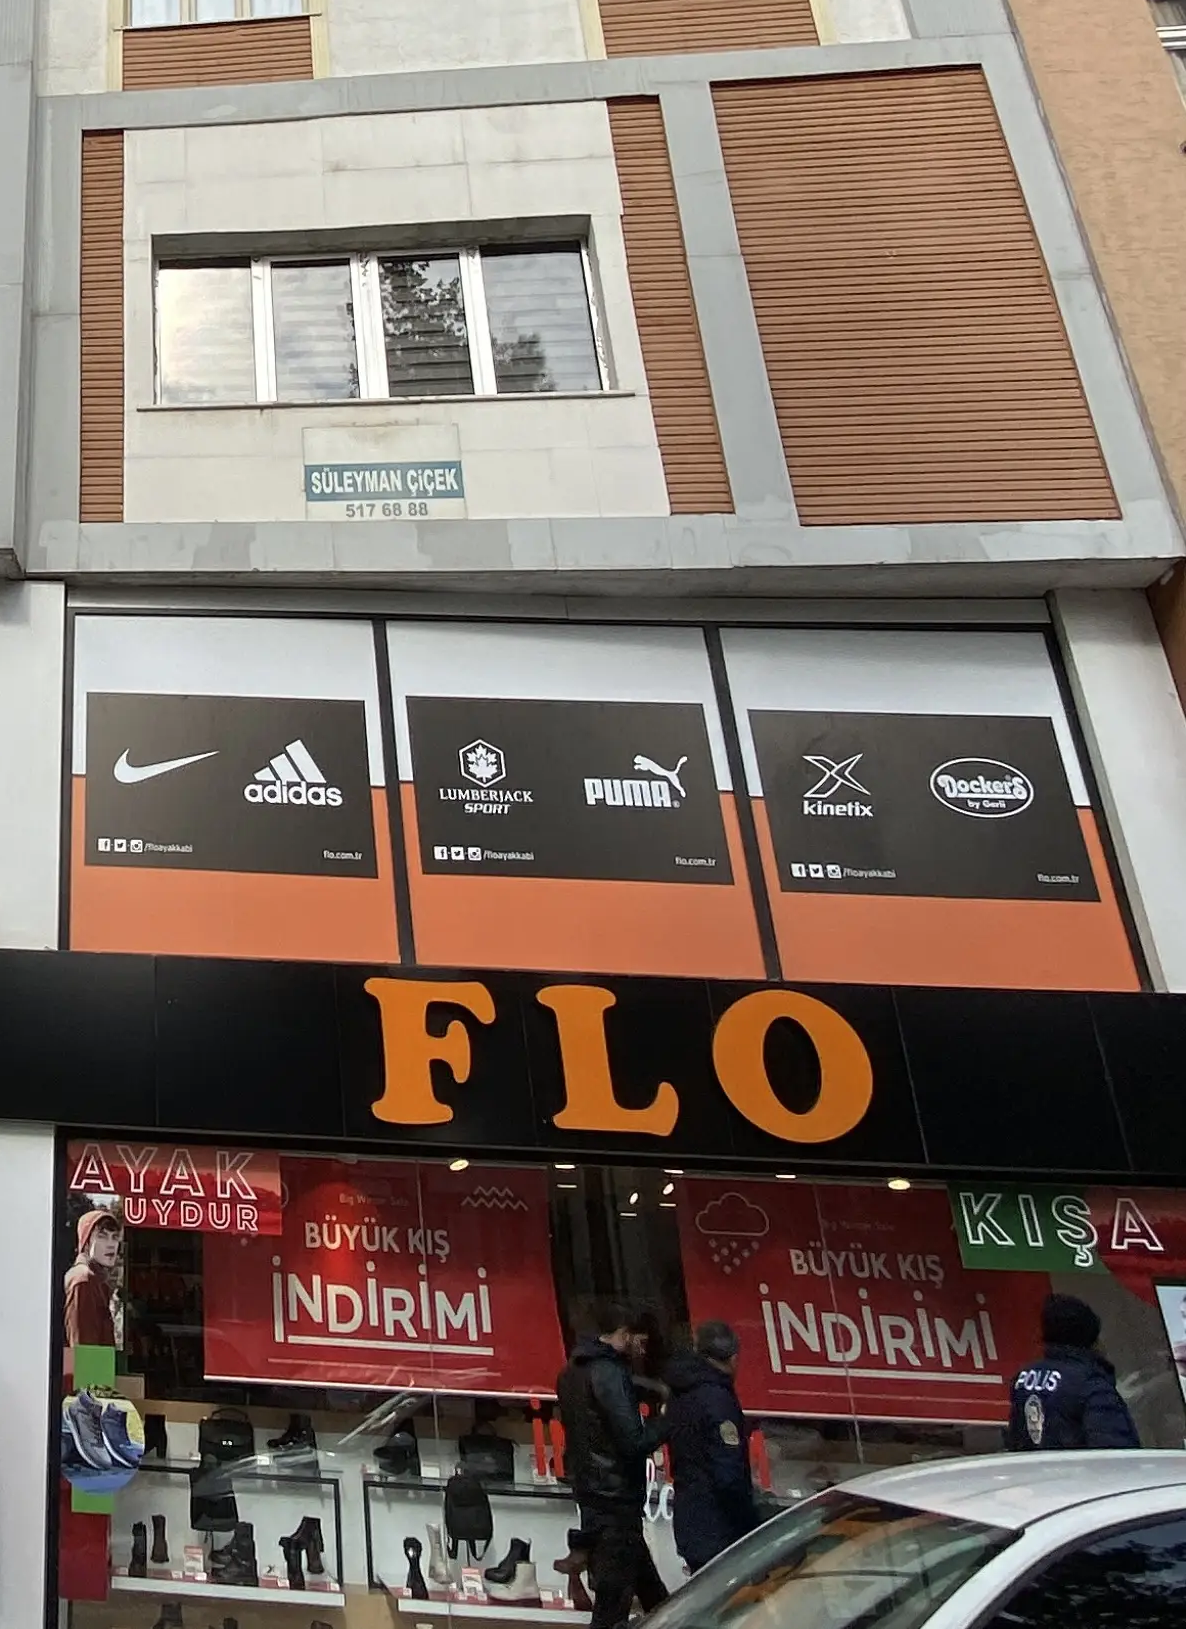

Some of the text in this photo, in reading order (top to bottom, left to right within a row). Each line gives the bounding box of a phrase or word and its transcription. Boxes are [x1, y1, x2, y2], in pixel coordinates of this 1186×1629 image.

[311, 468, 402, 494] SÜLEYMAN
[346, 502, 428, 518] 517 68 88
[243, 780, 343, 807] adidas
[439, 787, 534, 803] LUMBERJACK
[583, 778, 672, 808] PUMA
[967, 799, 980, 810] by
[463, 802, 511, 815] SPORT
[803, 801, 873, 818] kinetix
[323, 849, 363, 861] flo.com.tr
[675, 855, 716, 867] flo.com.tr
[363, 976, 874, 1144] FLO
[70, 1143, 257, 1201] AYAK
[124, 1197, 259, 1232] UYDUR
[304, 1214, 451, 1263] BÜYÜK KIŞ
[959, 1191, 1164, 1268] KIŞA
[789, 1240, 945, 1289] BÜYÜK KIŞ
[272, 1255, 493, 1343] İNDİRİMİ
[759, 1282, 999, 1373] İNDİRİMİ
